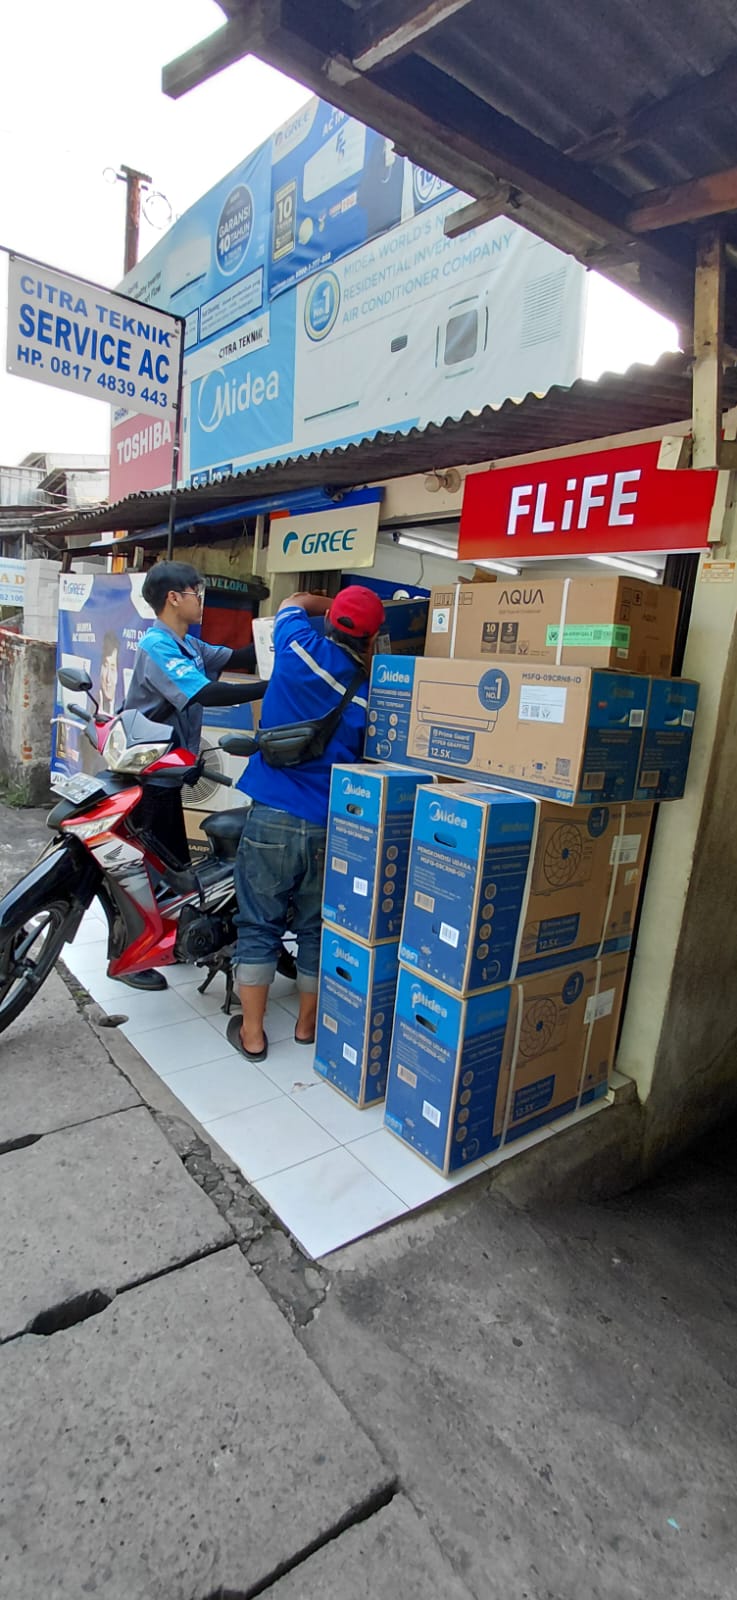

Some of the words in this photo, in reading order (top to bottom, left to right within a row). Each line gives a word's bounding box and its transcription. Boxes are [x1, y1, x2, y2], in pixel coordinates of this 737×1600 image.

[219, 203, 250, 238] GARANSI
[278, 195, 293, 223] 10
[218, 233, 231, 256] 10
[344, 252, 375, 277] MIDEA
[379, 217, 432, 259] WORLD'S
[342, 306, 359, 325] AIR
[361, 268, 439, 315] CONDITIONER
[443, 229, 517, 276] COMPANY
[343, 258, 410, 302] RESIDENTIAL
[20, 275, 88, 317] CITRA
[95, 303, 171, 348] TEKNIK
[19, 303, 132, 372] SERVICE
[138, 349, 170, 384] AC
[218, 341, 237, 359] CITRA
[238, 327, 264, 349] TEKNIK
[17, 344, 44, 368] HP.
[50, 356, 92, 383] 0817
[97, 373, 135, 397] 4839
[140, 387, 168, 408] 443
[198, 367, 279, 432] Midea
[117, 420, 172, 464] TOSHIBA
[301, 528, 358, 554] GREE
[205, 578, 248, 592] AVELOKA
[498, 589, 544, 605] AQUA
[486, 623, 496, 633] 10
[507, 623, 513, 633] 5
[377, 664, 410, 683] Midea
[495, 678, 503, 700] 1
[431, 747, 452, 759] 12.5X
[341, 777, 371, 799] Midea
[429, 801, 468, 829] Midea
[331, 940, 360, 968] Midea
[411, 983, 447, 1018] Midea
